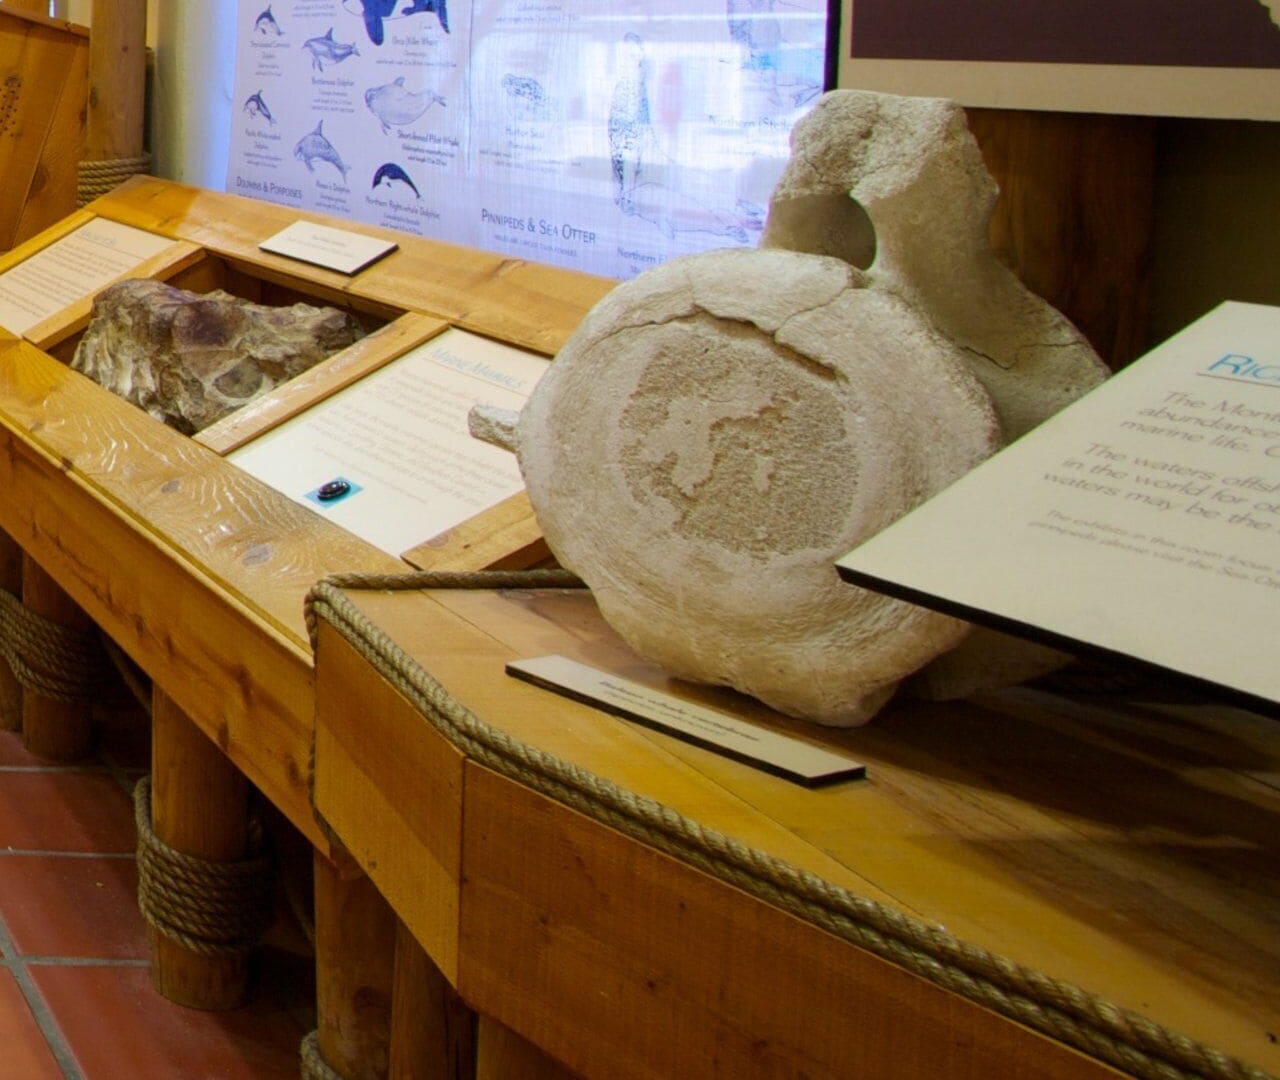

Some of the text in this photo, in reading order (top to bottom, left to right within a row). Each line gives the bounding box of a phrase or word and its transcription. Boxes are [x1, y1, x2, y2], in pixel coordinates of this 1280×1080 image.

[1162, 390, 1206, 408] The
[1084, 442, 1214, 480] The waters
